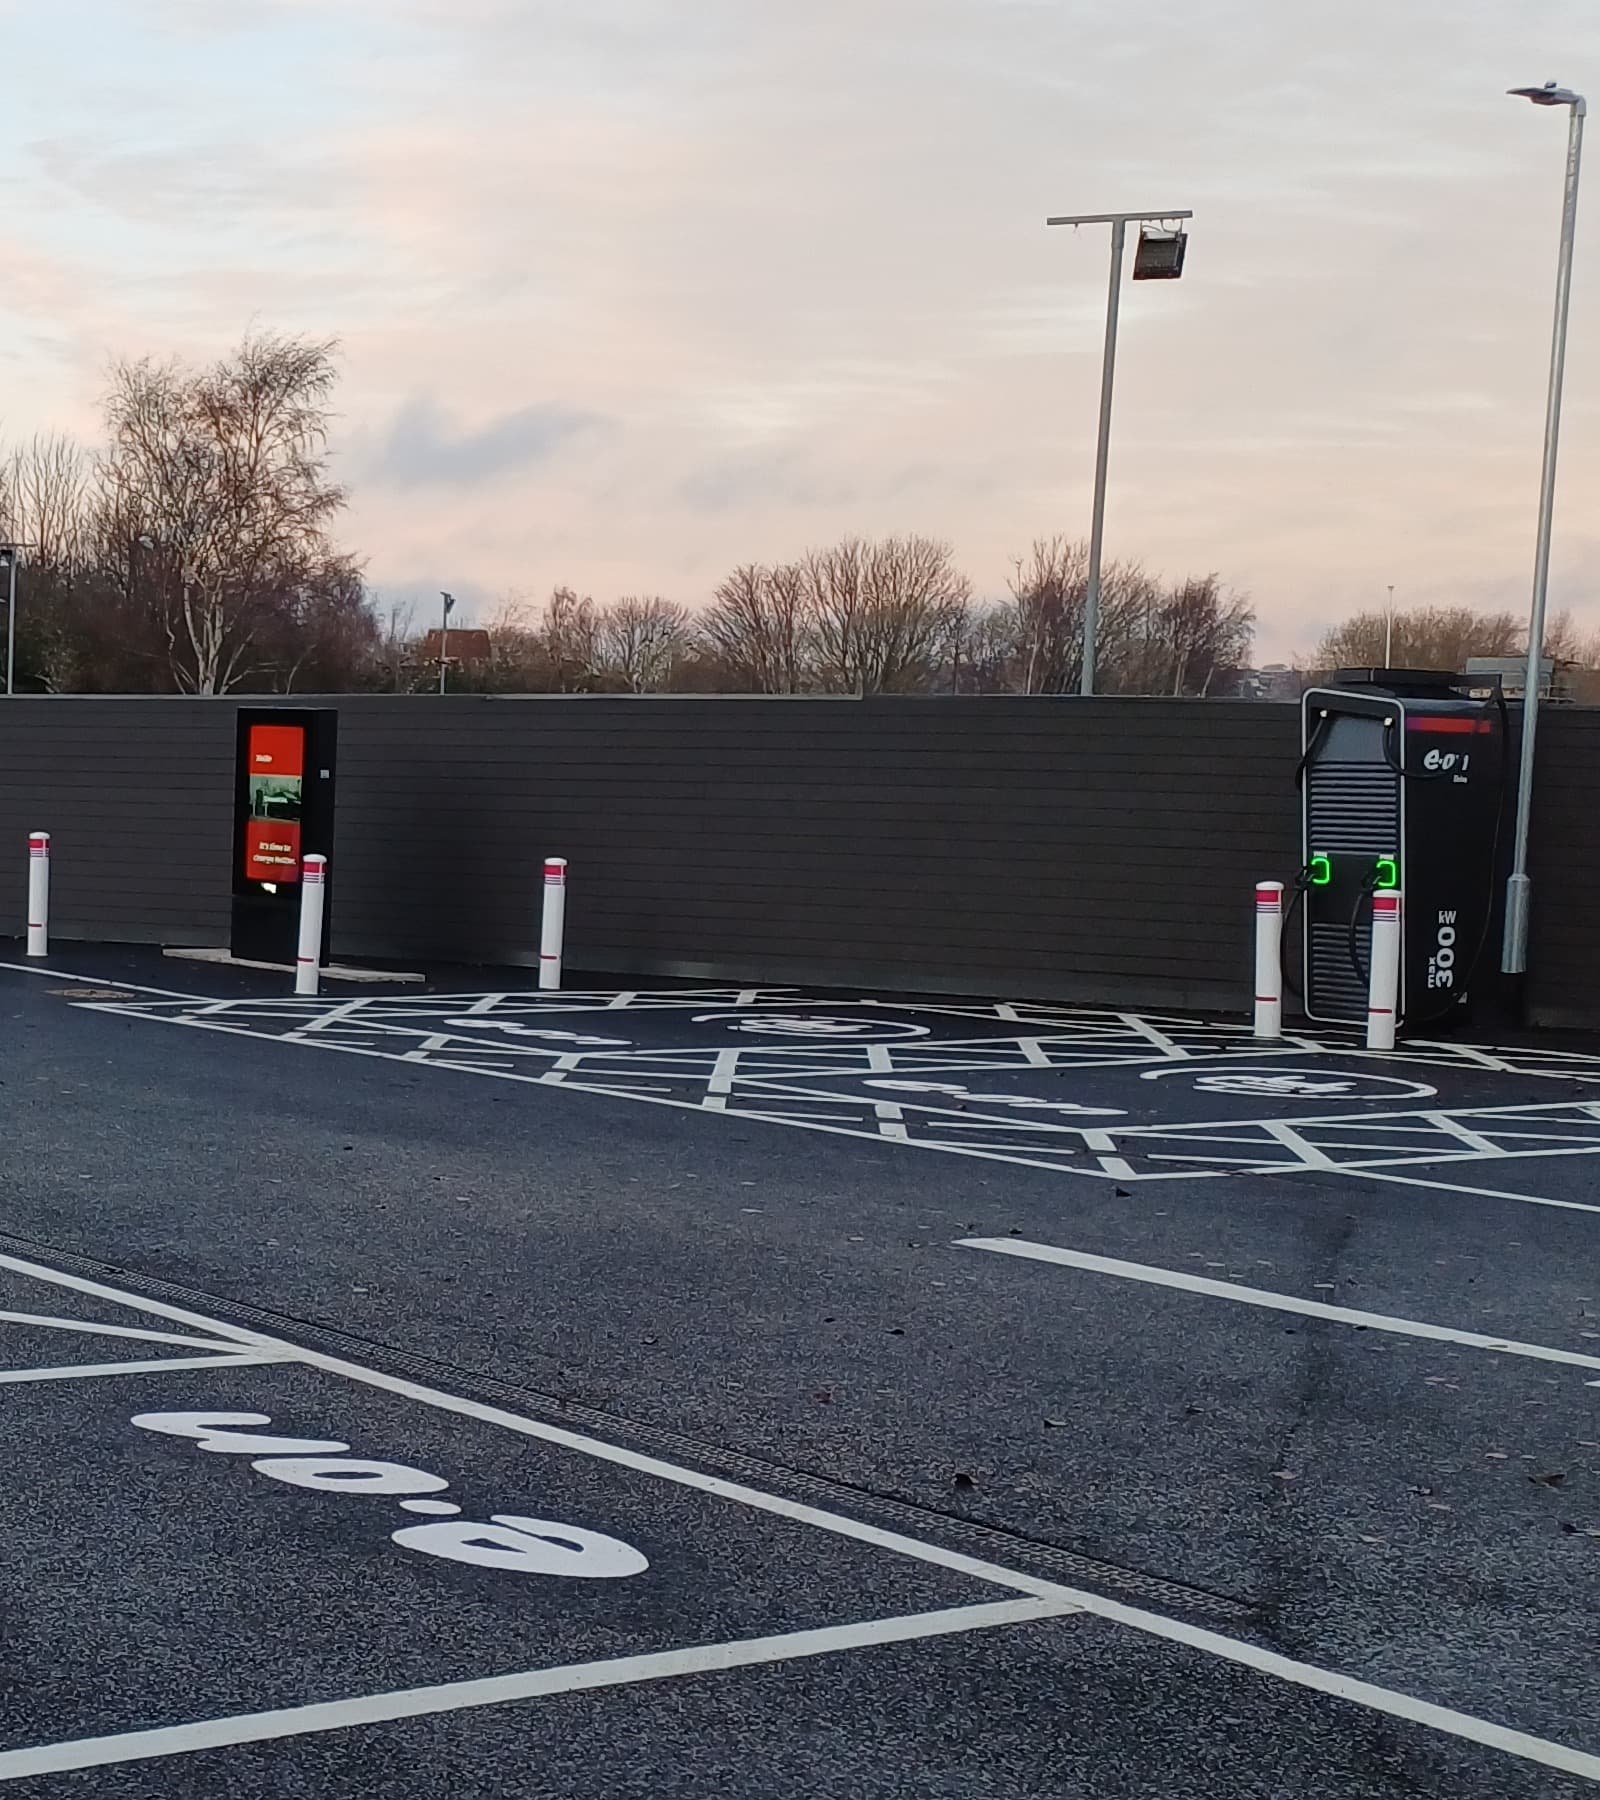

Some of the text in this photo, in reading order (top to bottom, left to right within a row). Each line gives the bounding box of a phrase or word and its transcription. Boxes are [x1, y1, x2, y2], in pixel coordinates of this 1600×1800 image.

[1438, 910, 1457, 925] kW
[1427, 956, 1436, 989] max
[1435, 926, 1456, 988] 300
